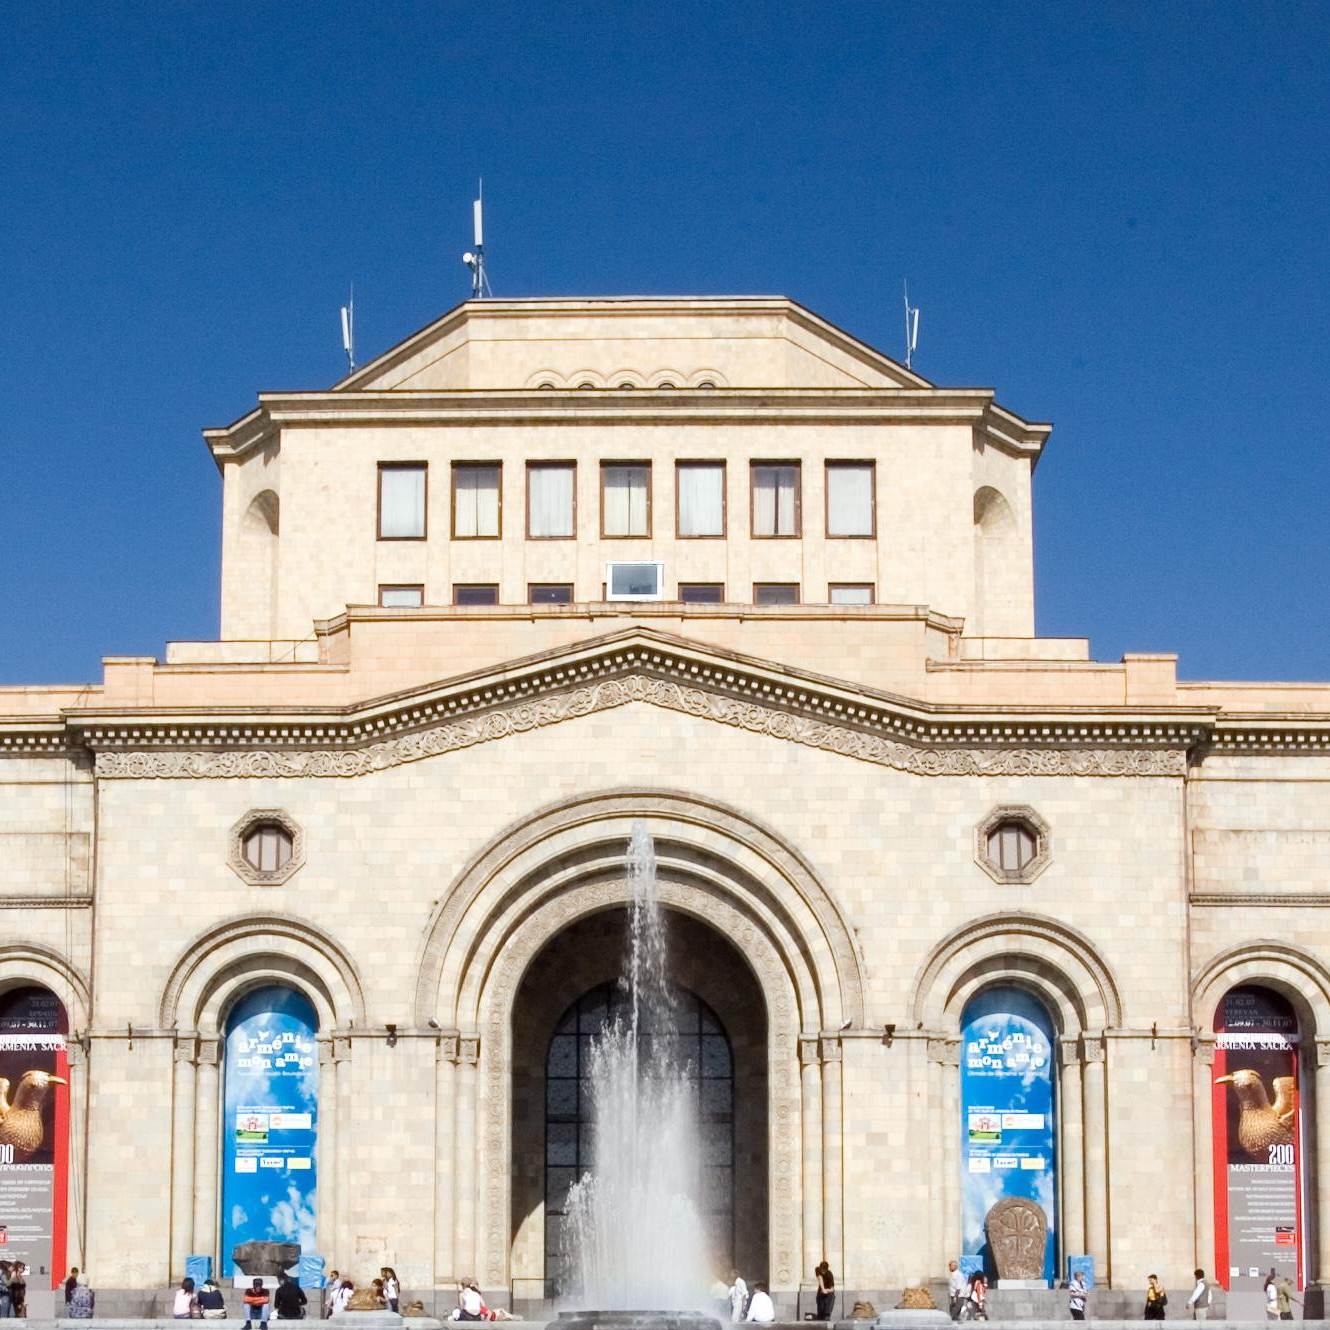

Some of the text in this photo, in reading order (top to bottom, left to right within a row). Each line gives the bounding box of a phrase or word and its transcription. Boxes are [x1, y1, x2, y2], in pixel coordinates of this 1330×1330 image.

[238, 1032, 313, 1054] arménie
[968, 1033, 1043, 1054] arménie
[1260, 1041, 1293, 1051] SACRA
[237, 1052, 313, 1070] mon amie
[967, 1052, 1045, 1070] mon amie
[1268, 1143, 1294, 1165] 200
[1230, 1163, 1296, 1173] MASTERPIECES
